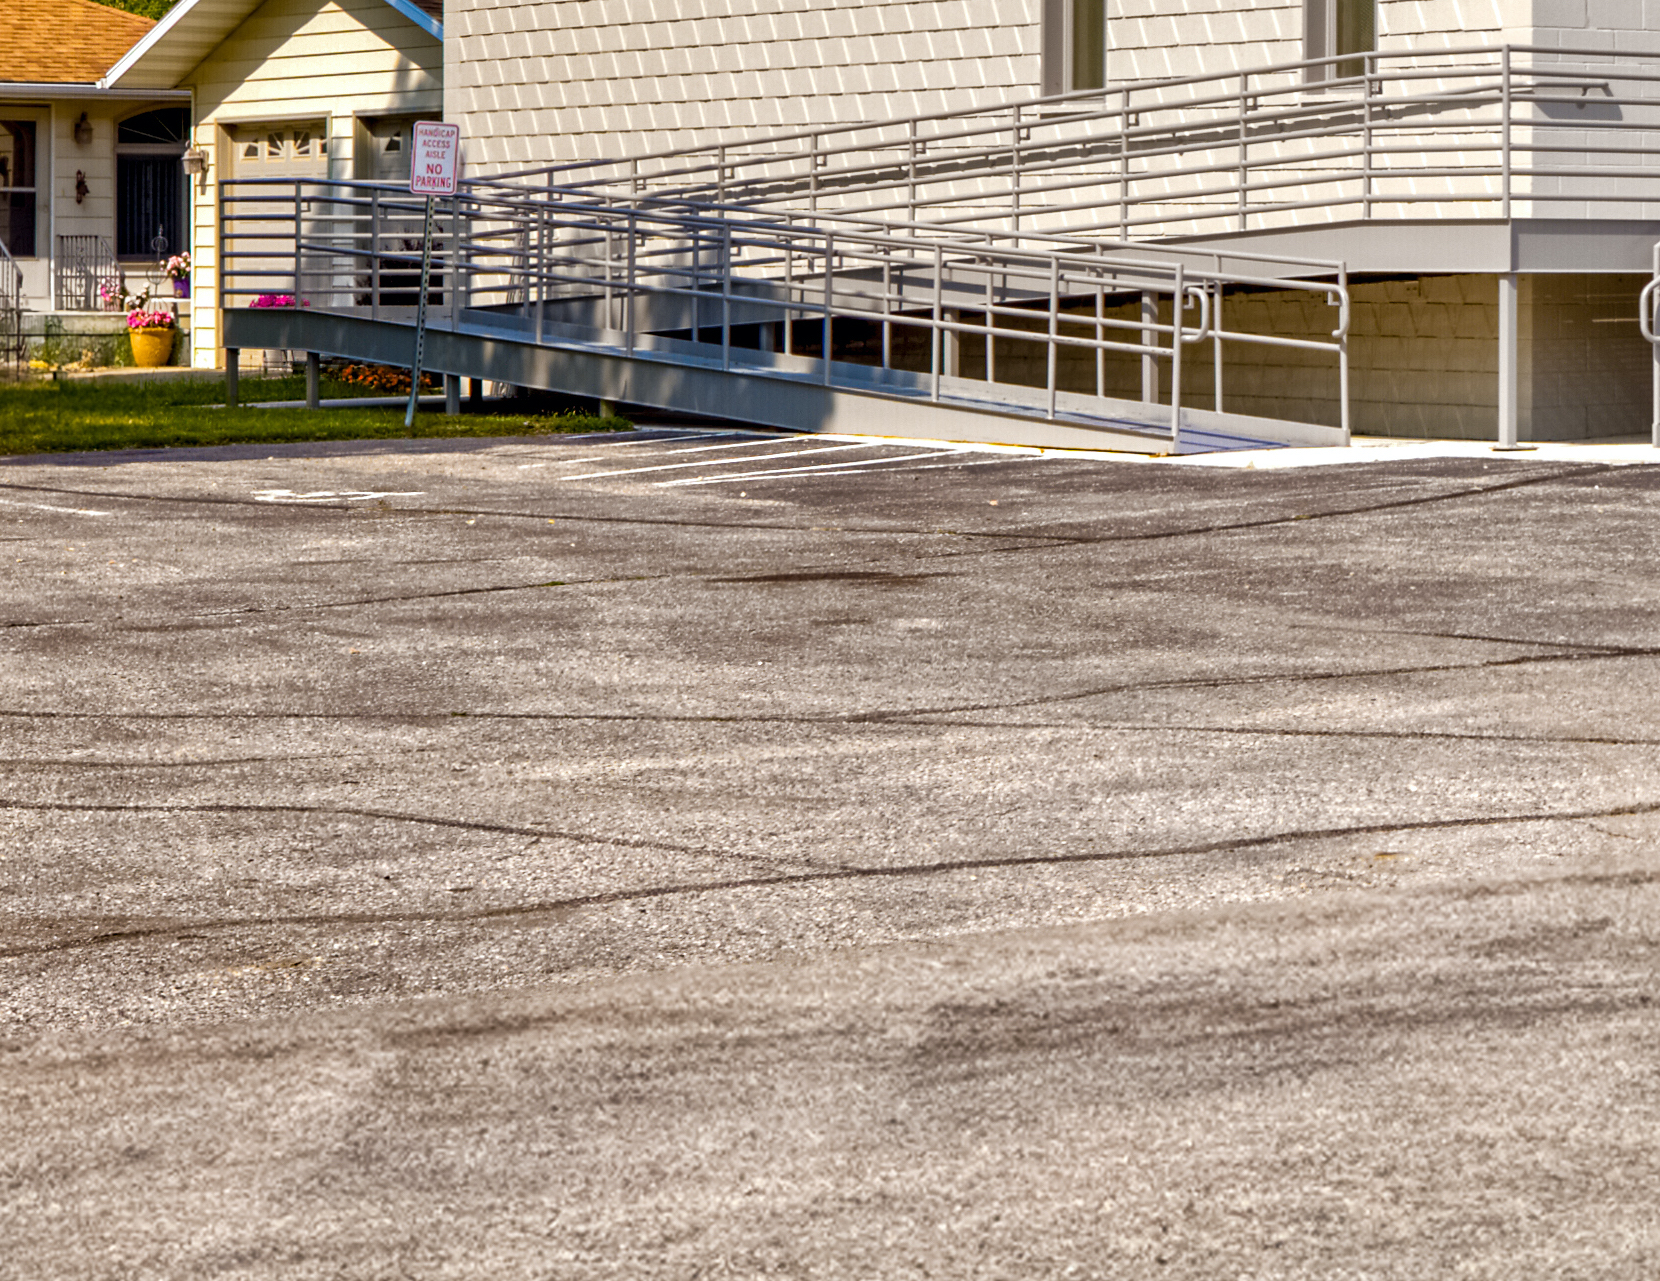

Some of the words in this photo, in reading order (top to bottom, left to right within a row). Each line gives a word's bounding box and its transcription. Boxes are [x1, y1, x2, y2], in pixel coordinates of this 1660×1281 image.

[419, 129, 455, 138] HANDICAP
[423, 140, 451, 149] ACCESS
[425, 150, 446, 159] AISLE
[426, 164, 443, 175] NO
[415, 176, 452, 188] PARKING
